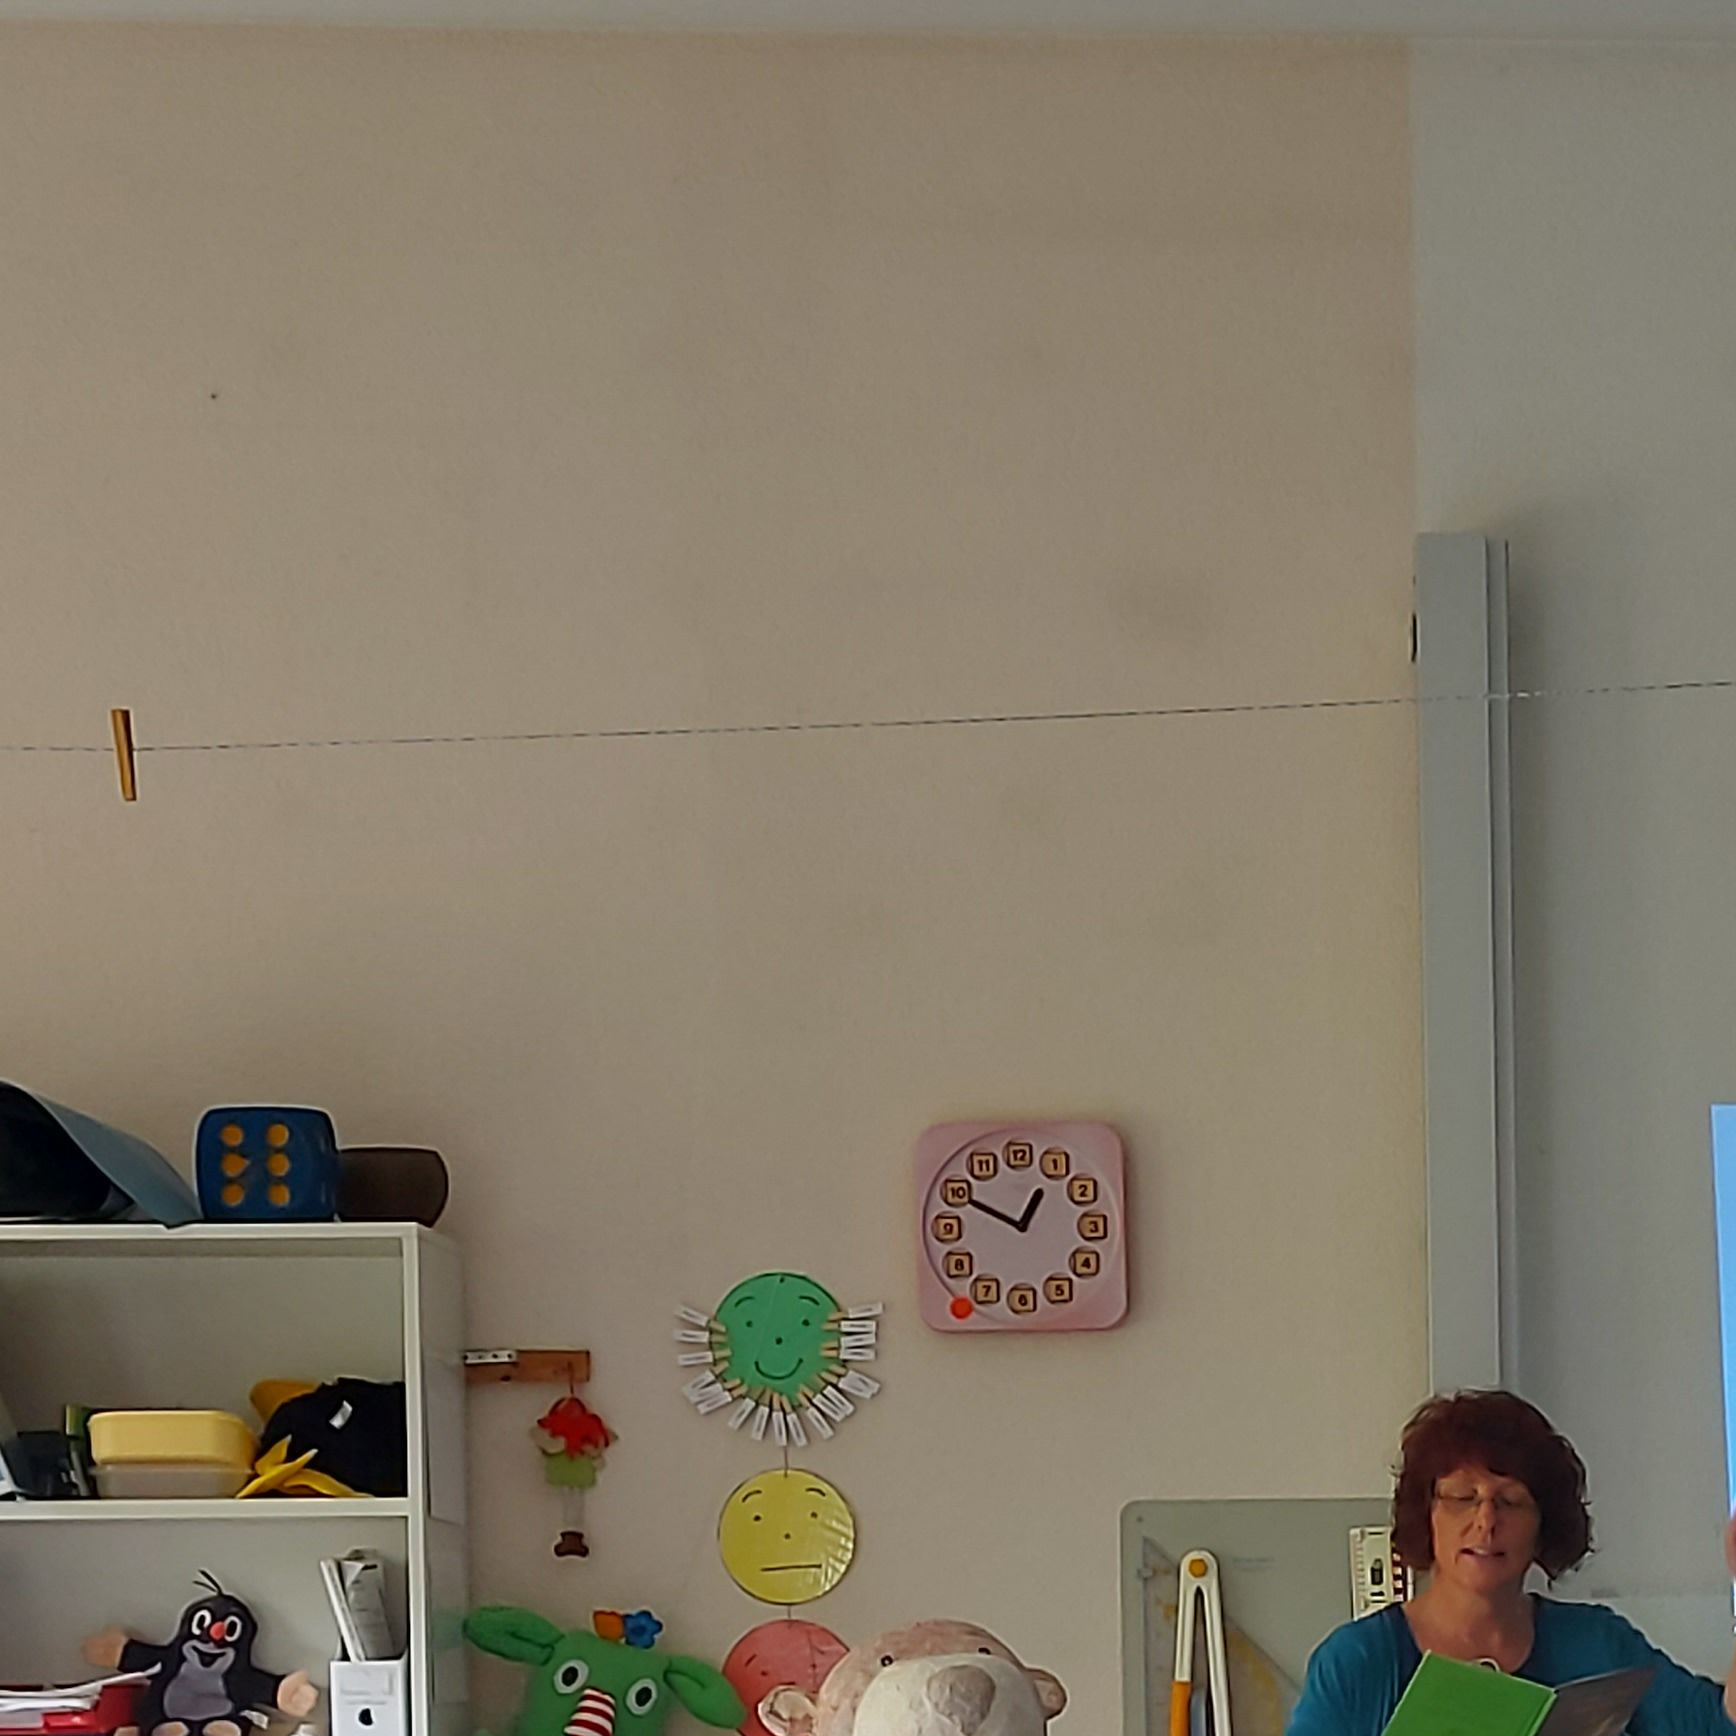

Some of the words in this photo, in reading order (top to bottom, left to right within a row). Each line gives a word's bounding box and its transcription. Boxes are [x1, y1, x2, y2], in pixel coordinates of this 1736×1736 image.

[1012, 1148, 1027, 1162] 12
[978, 1159, 991, 1173] 11
[1052, 1158, 1059, 1171] 1
[950, 1186, 966, 1200] 10
[1078, 1184, 1088, 1198] 2
[943, 1222, 953, 1236] 9
[1089, 1220, 1099, 1234] 3
[954, 1258, 964, 1271] 8
[1081, 1256, 1091, 1270] 4
[983, 1284, 993, 1298] 7
[1055, 1284, 1065, 1297] 5
[1018, 1293, 1028, 1307] 6
